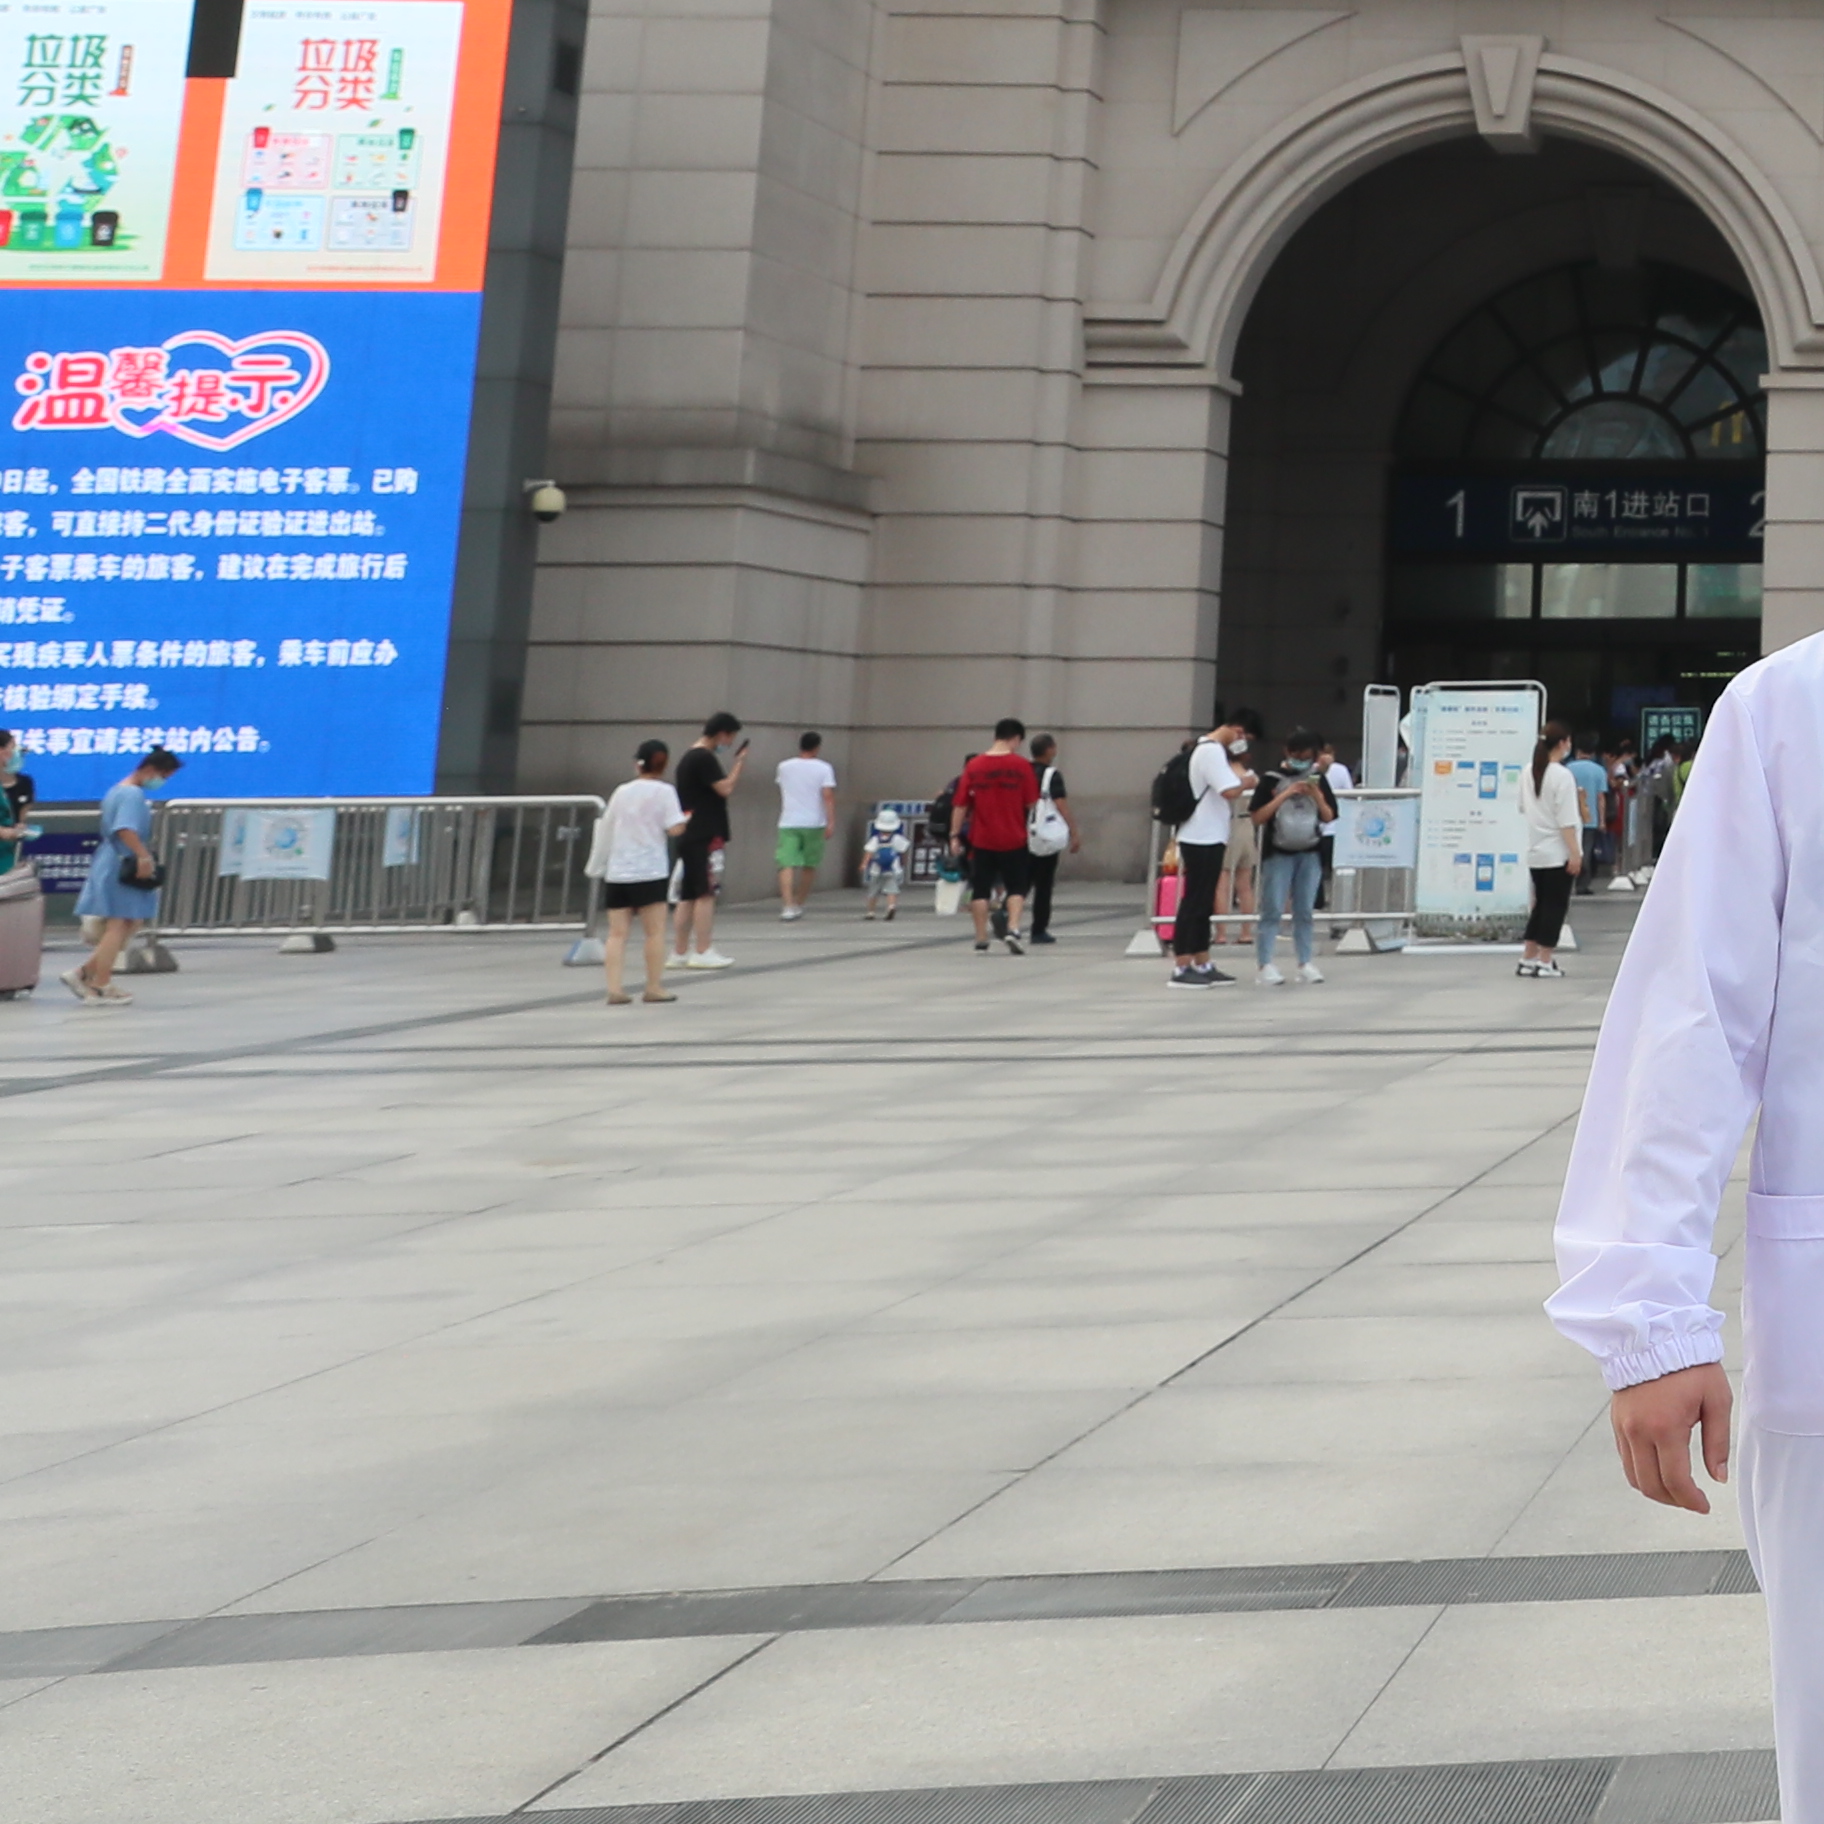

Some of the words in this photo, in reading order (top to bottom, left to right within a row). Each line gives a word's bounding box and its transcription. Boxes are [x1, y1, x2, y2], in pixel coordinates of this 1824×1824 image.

[21, 33, 108, 69] 垃圾
[296, 38, 380, 73] 垃圾
[17, 71, 103, 107] 分类
[293, 75, 375, 110] 分类
[13, 349, 302, 432] 温馨提示
[0, 467, 418, 494] 日起，全国铁路全面实施电子客票。已购
[1445, 489, 1465, 537] 1
[1573, 489, 1710, 518] 南1进站口
[0, 510, 386, 537] 客，可直接持二代身份证验证进出站。
[0, 683, 160, 711] 核验绑定手续。
